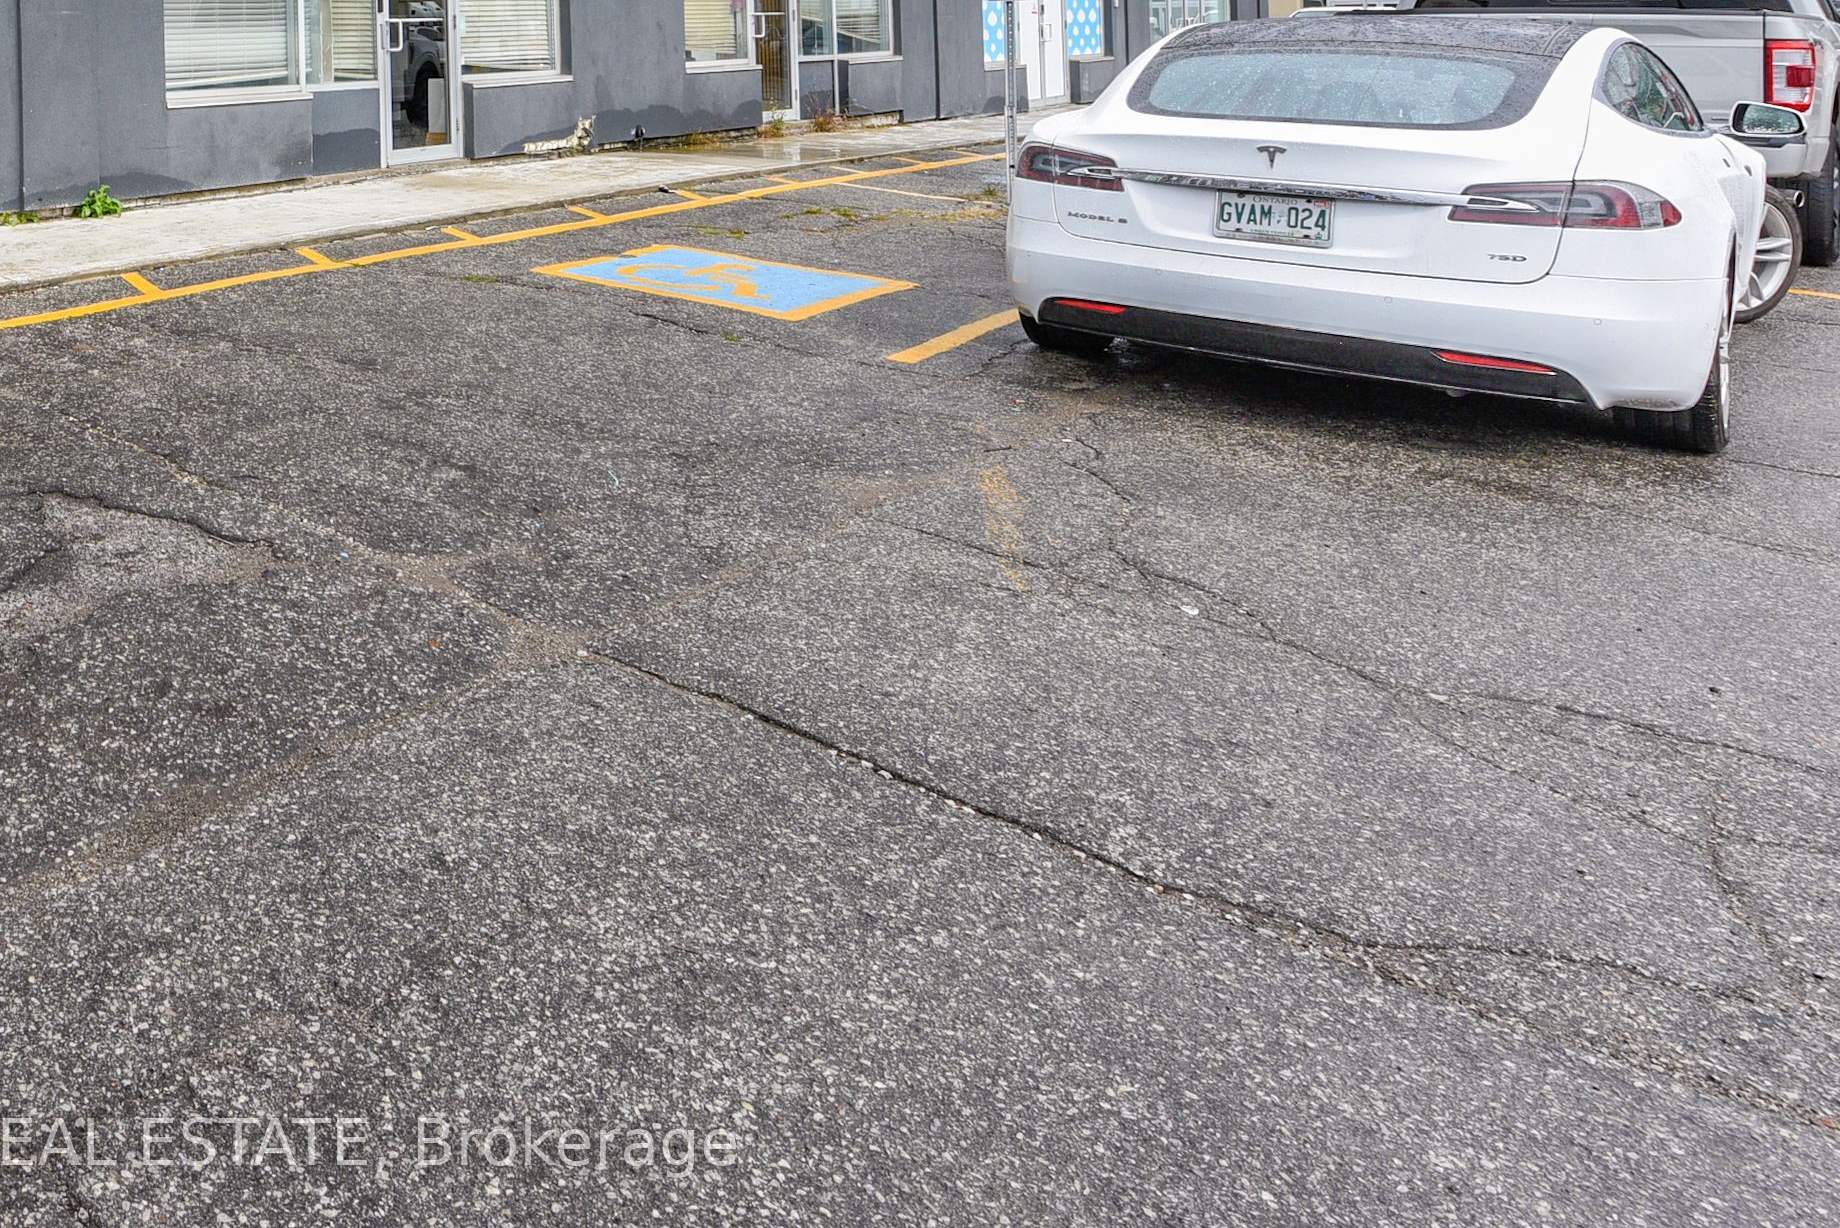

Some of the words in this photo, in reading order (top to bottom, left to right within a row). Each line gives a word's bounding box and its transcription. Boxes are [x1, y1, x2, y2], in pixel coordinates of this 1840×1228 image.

[1252, 195, 1298, 205] ONTARIO
[1067, 211, 1114, 222] MODEL
[1220, 201, 1273, 227] GVAM
[1286, 206, 1327, 231] 024
[1487, 253, 1527, 262] 75D
